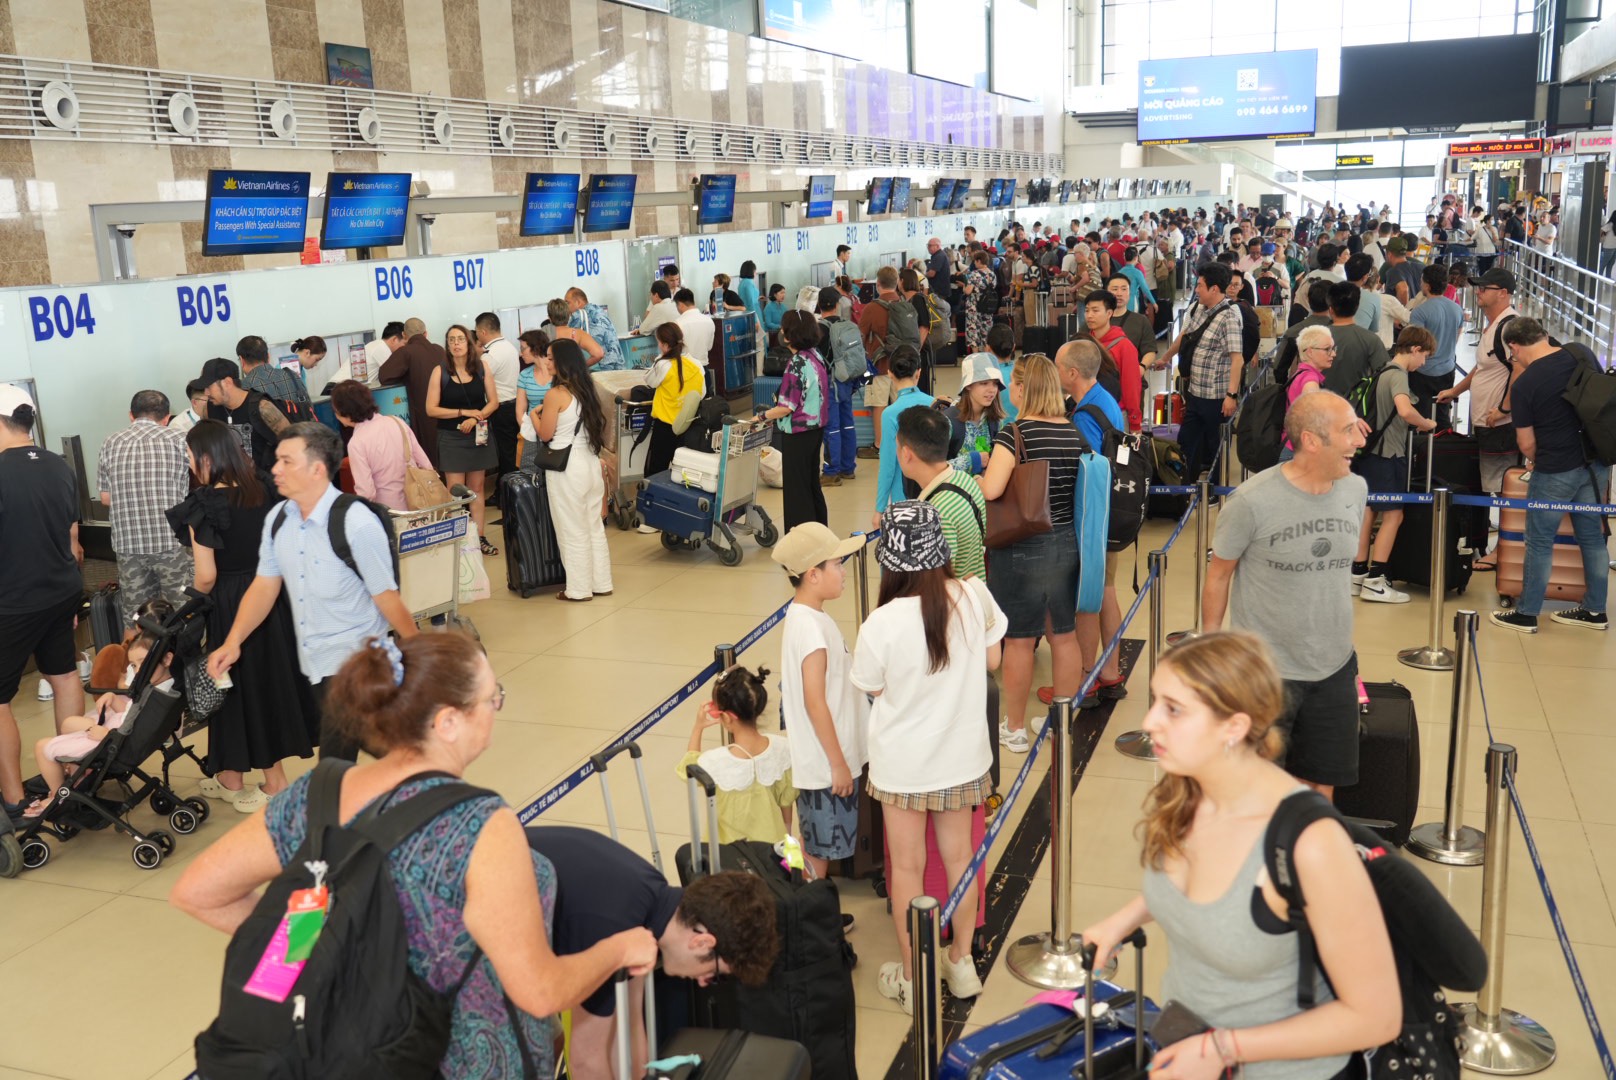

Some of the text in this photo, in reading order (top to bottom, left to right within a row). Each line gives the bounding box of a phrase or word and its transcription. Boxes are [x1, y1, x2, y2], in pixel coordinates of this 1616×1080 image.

[1143, 113, 1193, 122] ADVERTISING
[1236, 104, 1308, 116] 090 464 6699
[1495, 160, 1521, 170] CAFE
[237, 180, 291, 191] Vietnam Airlines
[215, 206, 236, 217] KHÁCH
[214, 220, 301, 232] Passengers With Special Assistance
[846, 226, 858, 245] B12
[868, 223, 879, 242] B13
[907, 221, 916, 238] B14
[698, 238, 716, 262] B09
[766, 233, 781, 255] B10
[797, 230, 810, 251] B11
[575, 249, 600, 277] B08
[374, 265, 413, 301] B06
[453, 257, 485, 292] B07
[176, 283, 231, 327] B05
[28, 292, 96, 342] B04
[1378, 494, 1389, 502] NỘI
[1390, 494, 1403, 502] BÀI
[1528, 501, 1549, 510] CẢNG
[1551, 503, 1573, 511] HÀNG
[1574, 504, 1602, 512] KHÔNG
[1269, 517, 1359, 548] PRINCETON
[1266, 558, 1352, 572] TRACK & FIEL
[520, 805, 539, 824] QUỐC
[547, 789, 559, 804] NỘI
[558, 781, 569, 796] BÀI
[580, 762, 594, 778] N.I.A
[623, 710, 661, 744] INTERNATIONAL
[660, 695, 679, 715] AIRPORT
[687, 680, 699, 693] N.I.A
